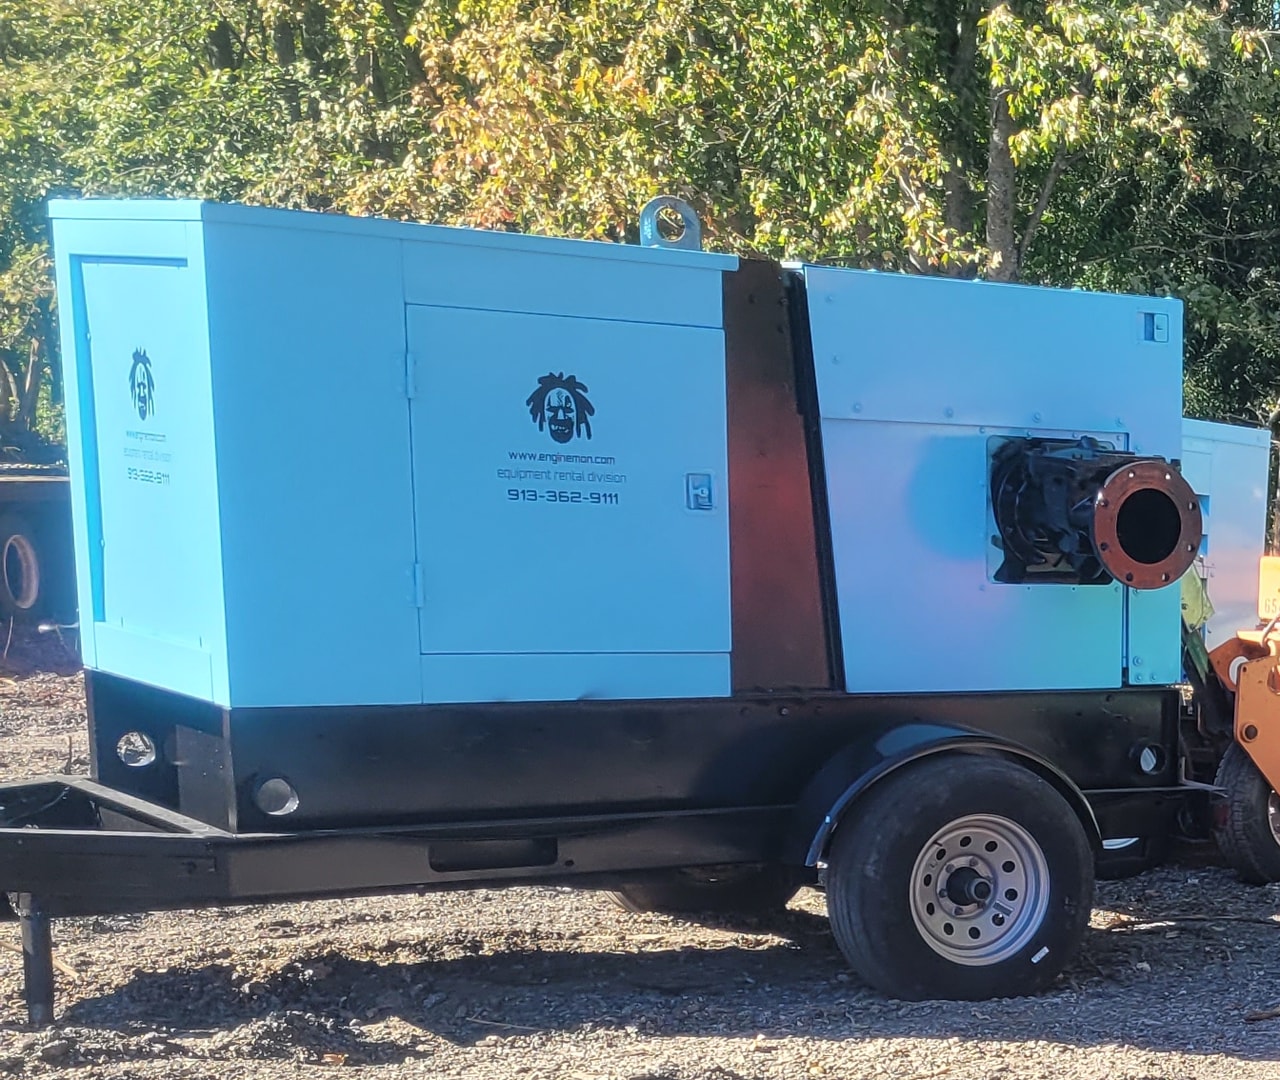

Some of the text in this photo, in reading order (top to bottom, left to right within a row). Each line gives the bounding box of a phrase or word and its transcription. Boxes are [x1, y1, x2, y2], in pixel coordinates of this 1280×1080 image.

[497, 468, 627, 484] equipment rental division
[507, 488, 619, 505] 913-362-9111
